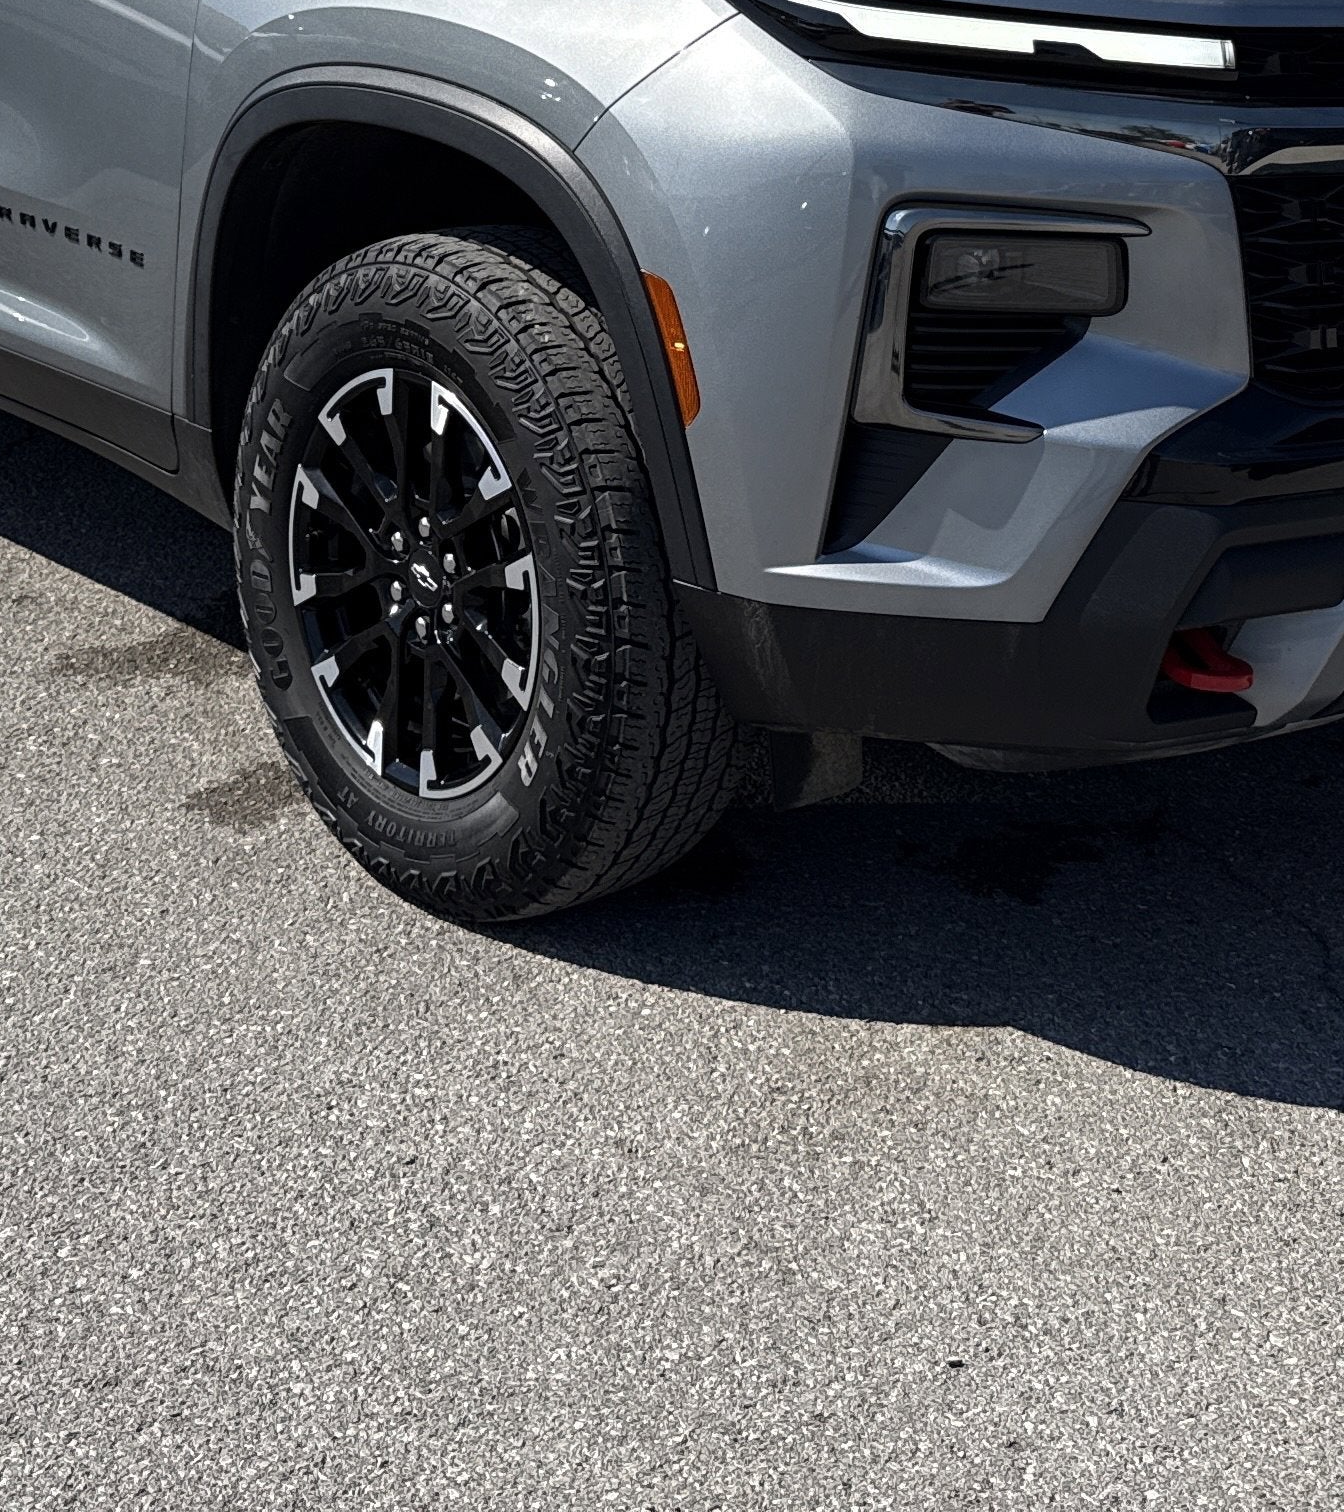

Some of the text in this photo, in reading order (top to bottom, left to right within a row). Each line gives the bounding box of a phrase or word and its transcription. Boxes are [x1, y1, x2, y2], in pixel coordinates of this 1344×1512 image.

[514, 467, 562, 788] WRANGLER
[335, 785, 360, 810] AT
[363, 808, 459, 849] TERRITORY
